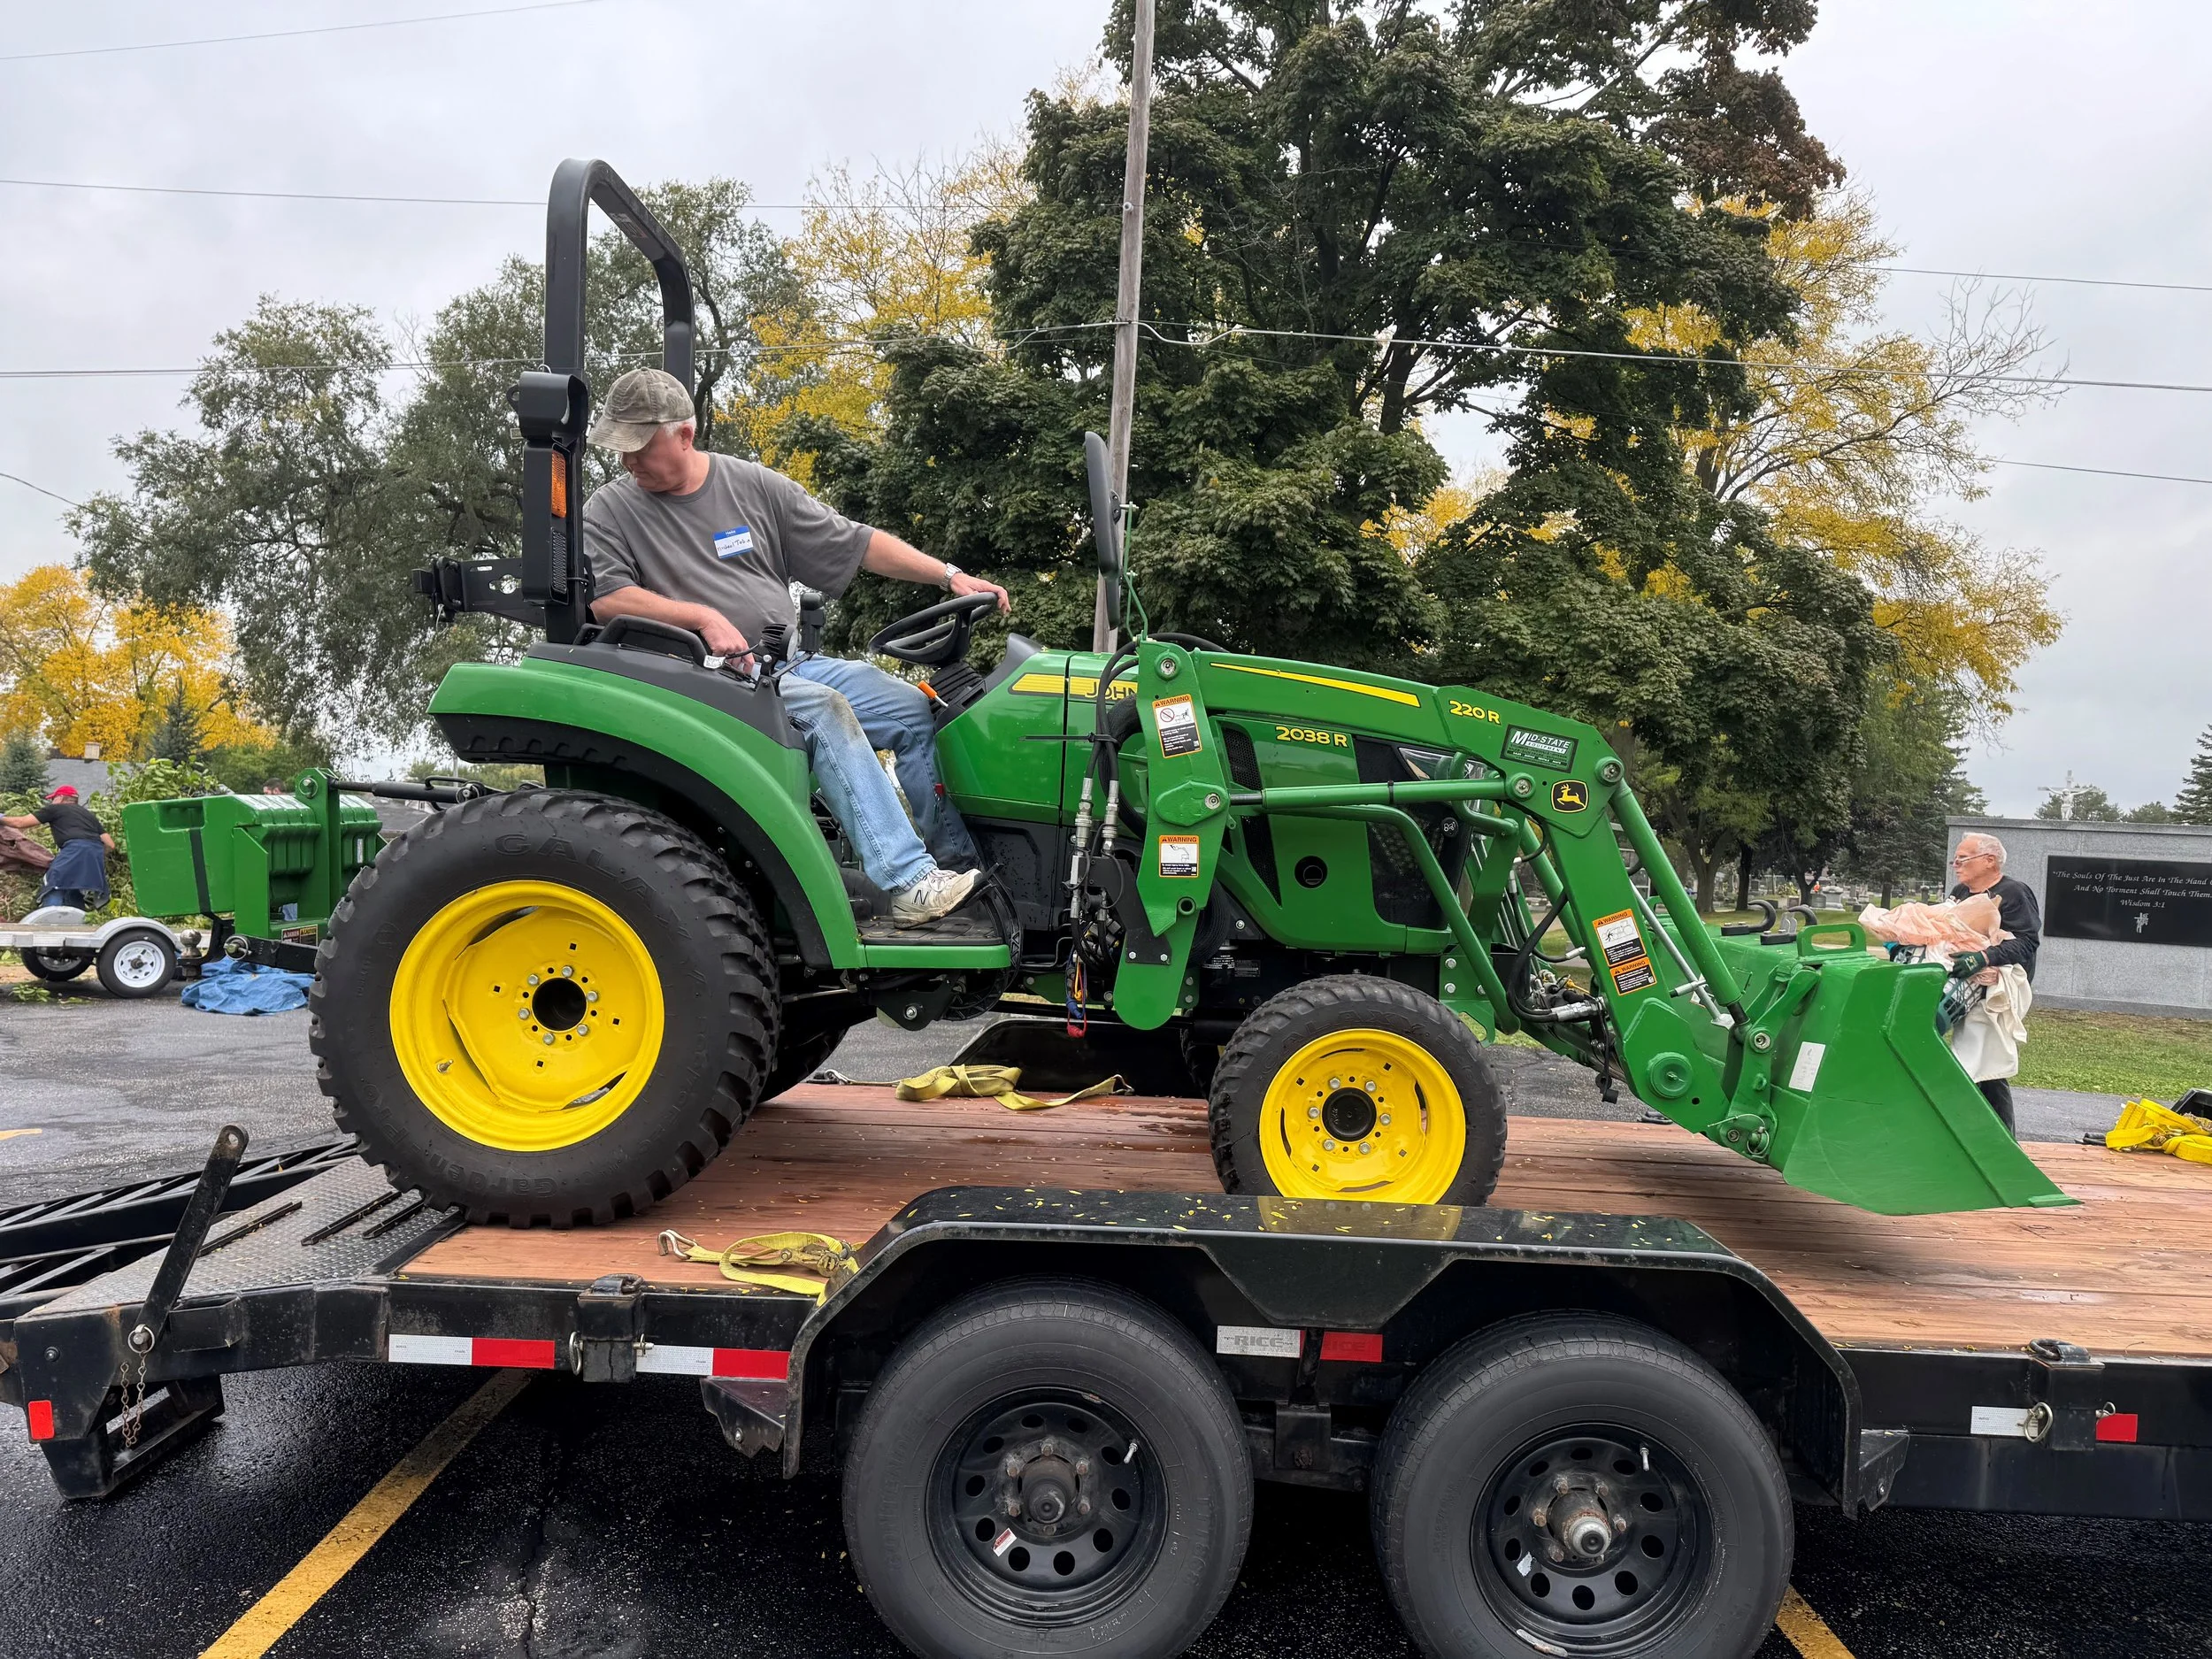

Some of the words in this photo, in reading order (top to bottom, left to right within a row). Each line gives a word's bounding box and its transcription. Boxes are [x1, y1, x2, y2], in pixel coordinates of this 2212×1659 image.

[1161, 695, 1190, 706] WARNING
[1449, 700, 1486, 719] 220
[1487, 710, 1502, 725] R
[1275, 726, 1331, 745] 2038
[1333, 733, 1348, 748] R
[1510, 730, 1571, 749] MID-STATE
[1527, 741, 1565, 754] EQUIPMENT
[2094, 872, 2106, 882] Of
[2185, 877, 2208, 886] Hand
[2092, 885, 2104, 894] No
[2106, 886, 2138, 895] Torment
[2139, 887, 2162, 895] Shall
[2162, 888, 2186, 897] Touch
[2120, 899, 2150, 908] Wisdom
[1603, 911, 1628, 924] WARNING
[1621, 960, 1646, 972] WARNING
[1234, 1334, 1284, 1348] RICE
